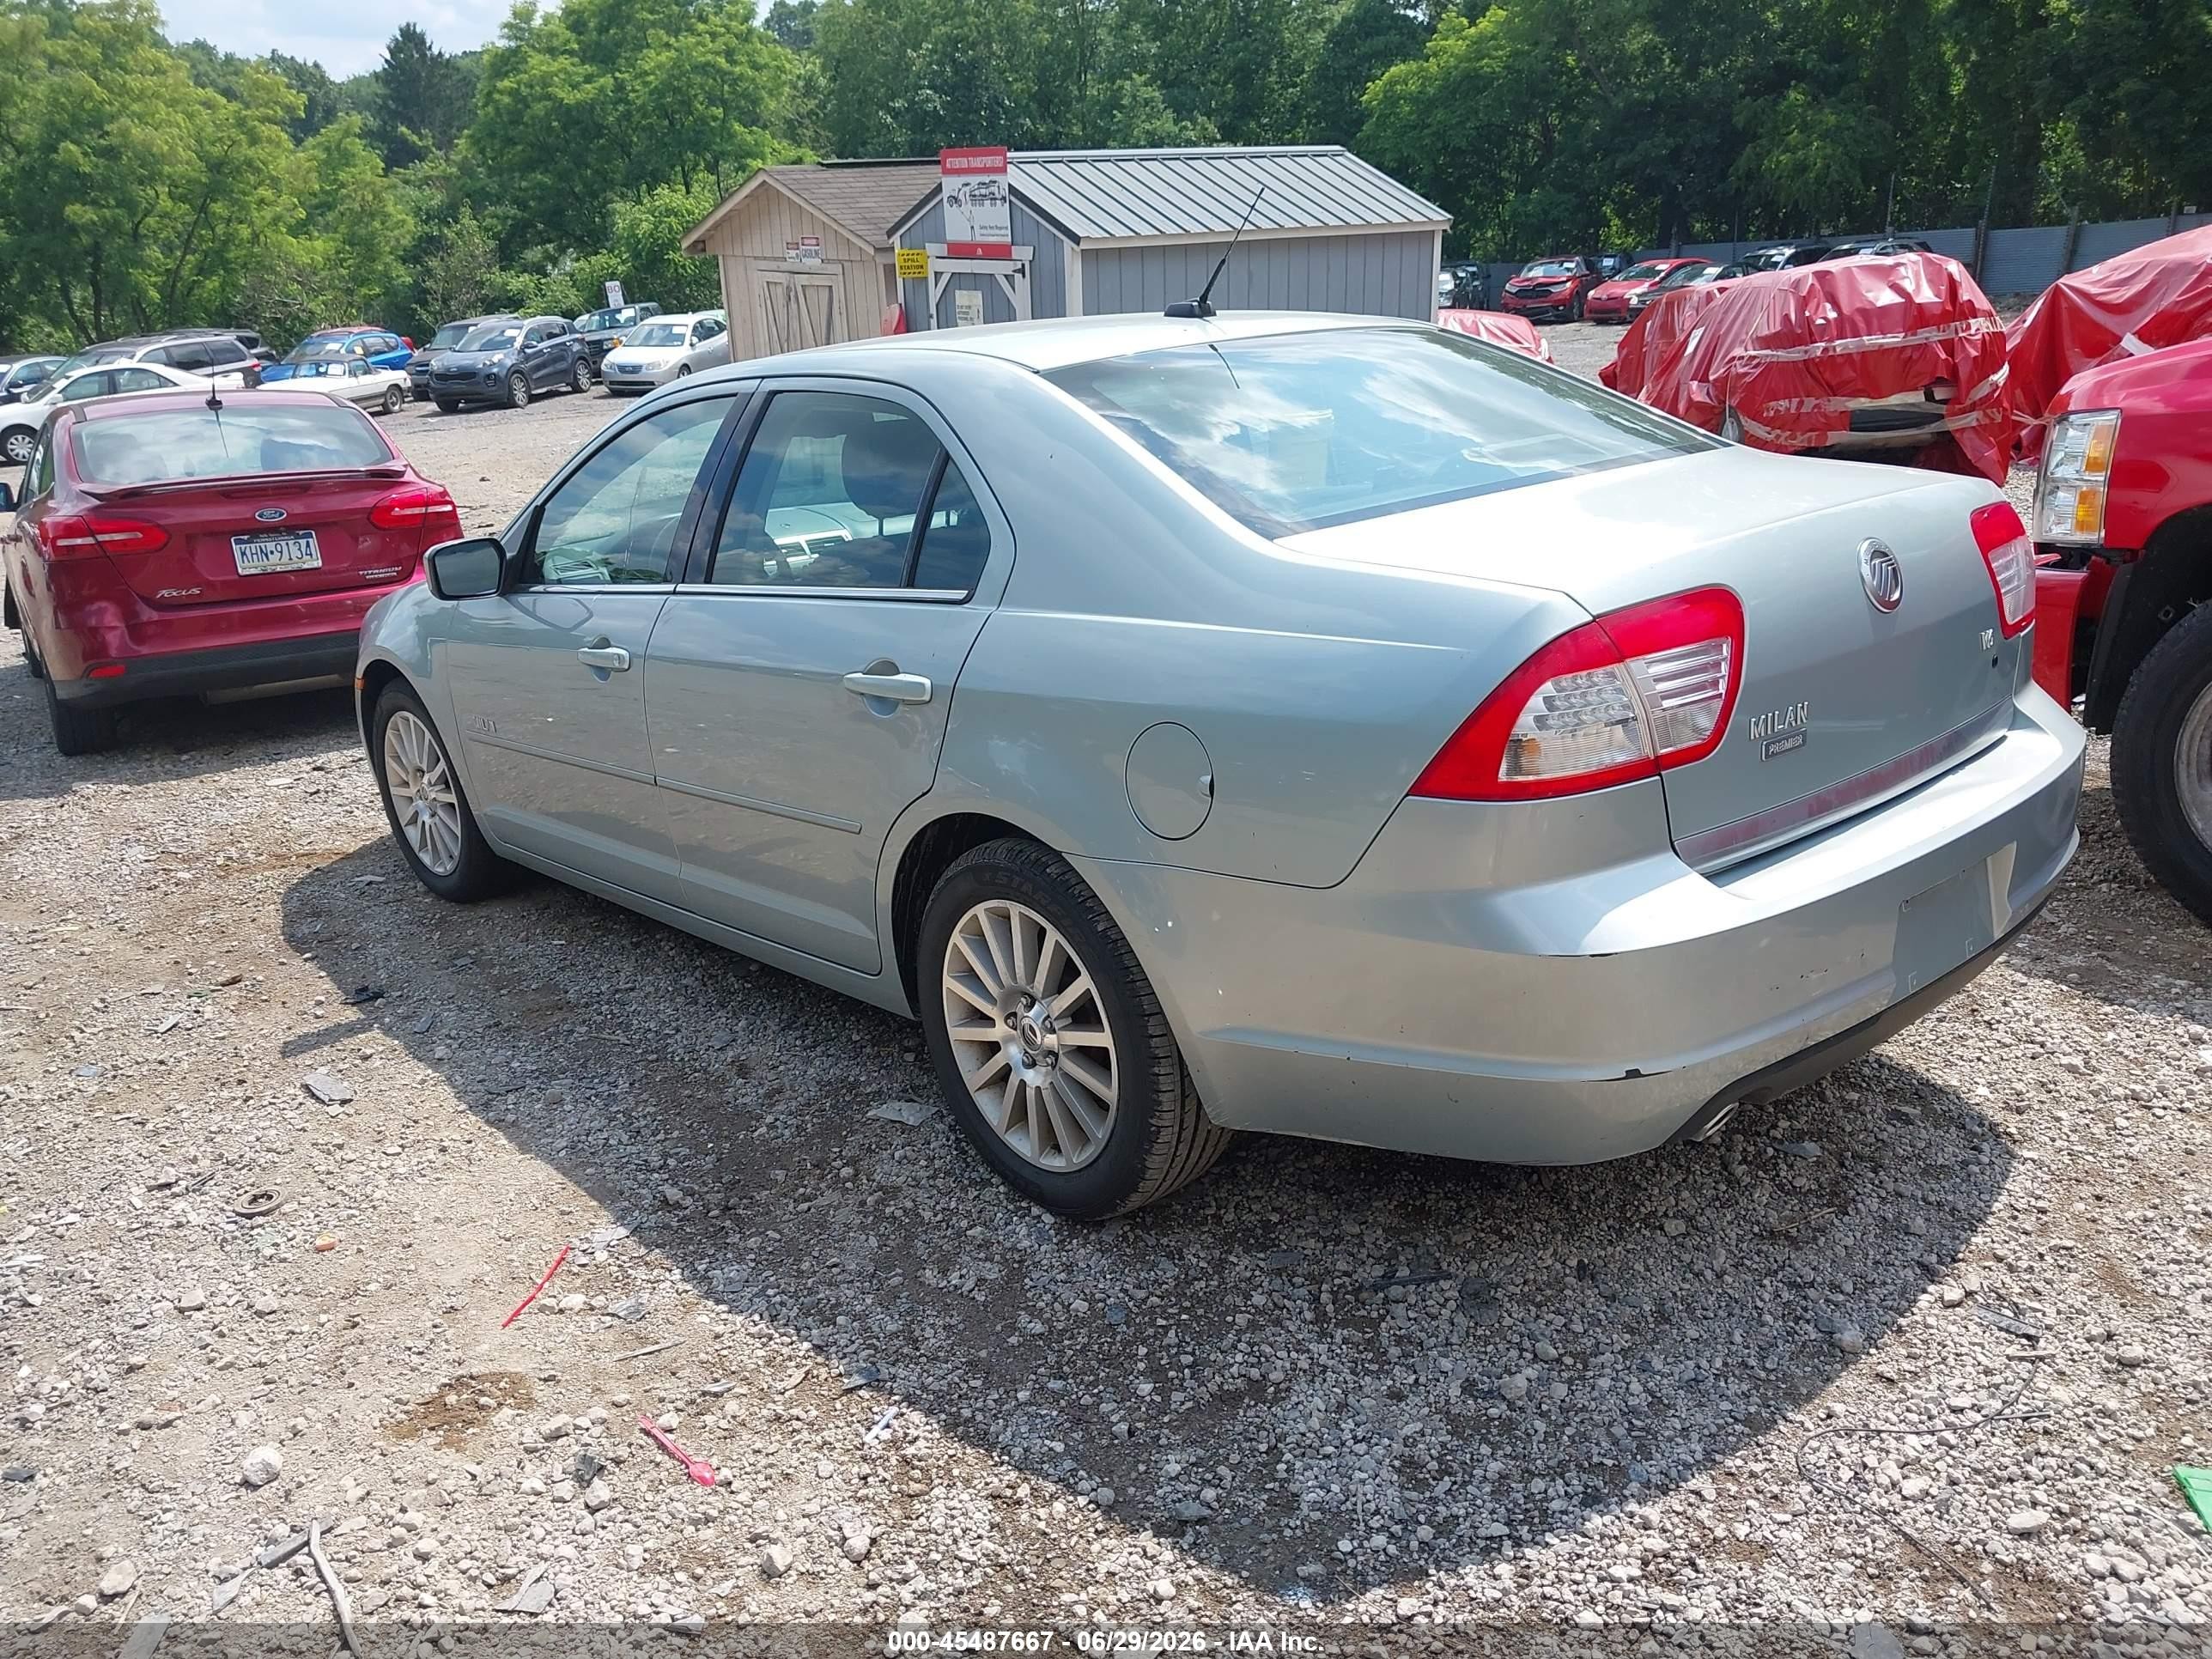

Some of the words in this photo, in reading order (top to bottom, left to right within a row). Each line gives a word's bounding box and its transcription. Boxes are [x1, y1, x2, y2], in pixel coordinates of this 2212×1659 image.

[1978, 628, 1994, 650] V6
[1750, 701, 1808, 740] MILAN
[1768, 734, 1803, 756] PREMIER
